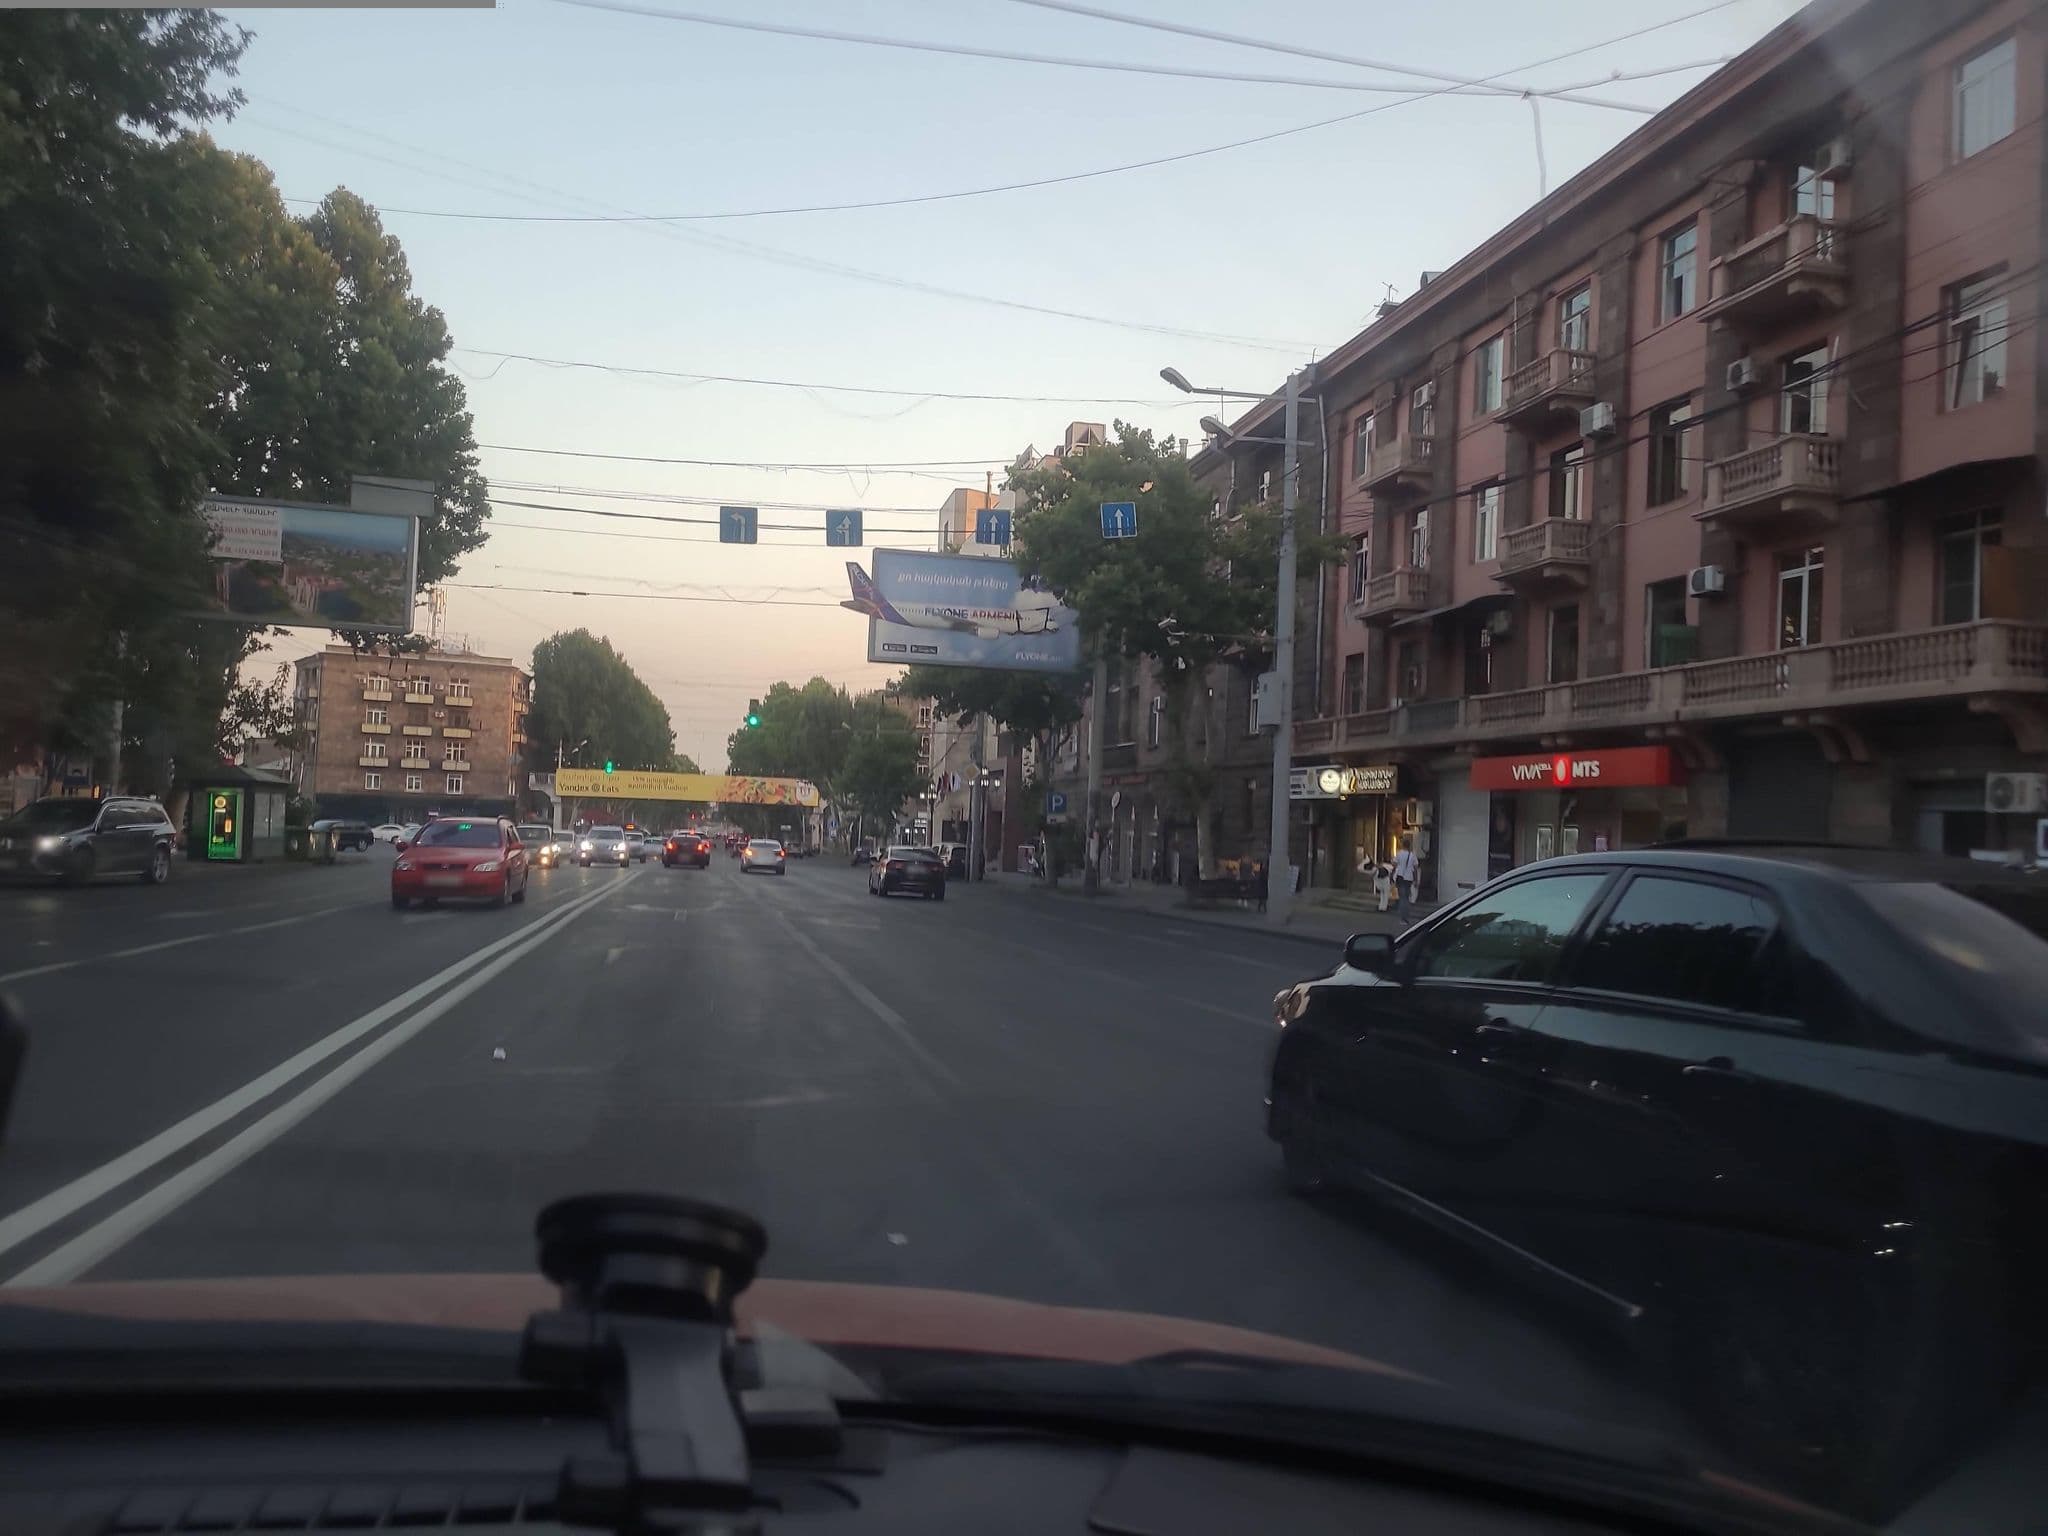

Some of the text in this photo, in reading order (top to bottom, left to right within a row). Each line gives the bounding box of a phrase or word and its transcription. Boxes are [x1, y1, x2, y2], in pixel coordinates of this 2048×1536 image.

[924, 607, 969, 619] FLYONE
[1572, 761, 1600, 778] MTS
[559, 782, 620, 793] Yandex Eats
[1052, 794, 1064, 812] P
